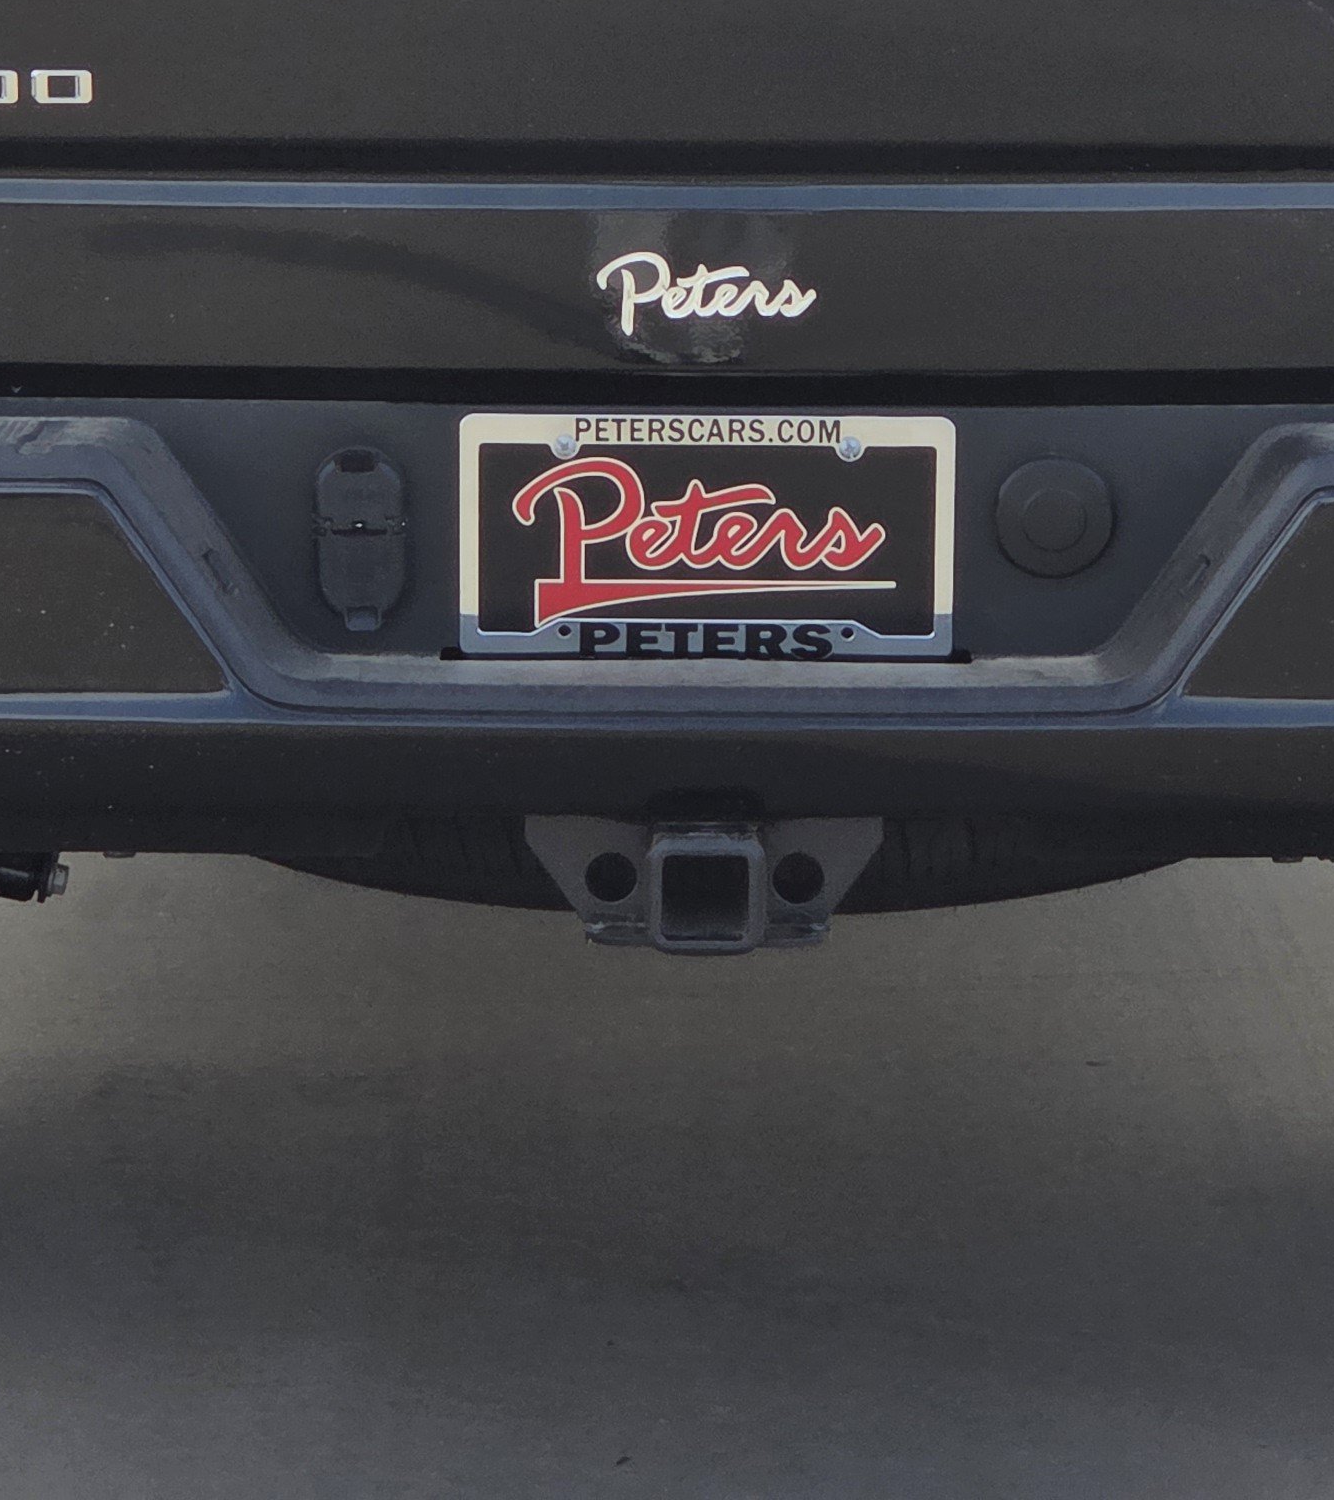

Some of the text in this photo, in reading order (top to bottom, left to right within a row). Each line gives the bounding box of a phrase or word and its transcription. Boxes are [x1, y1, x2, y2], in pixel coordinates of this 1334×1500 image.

[596, 251, 817, 336] Peters
[574, 417, 842, 444] PETERSCARS.COM
[513, 457, 887, 590] Peters
[578, 621, 834, 659] PETERS
